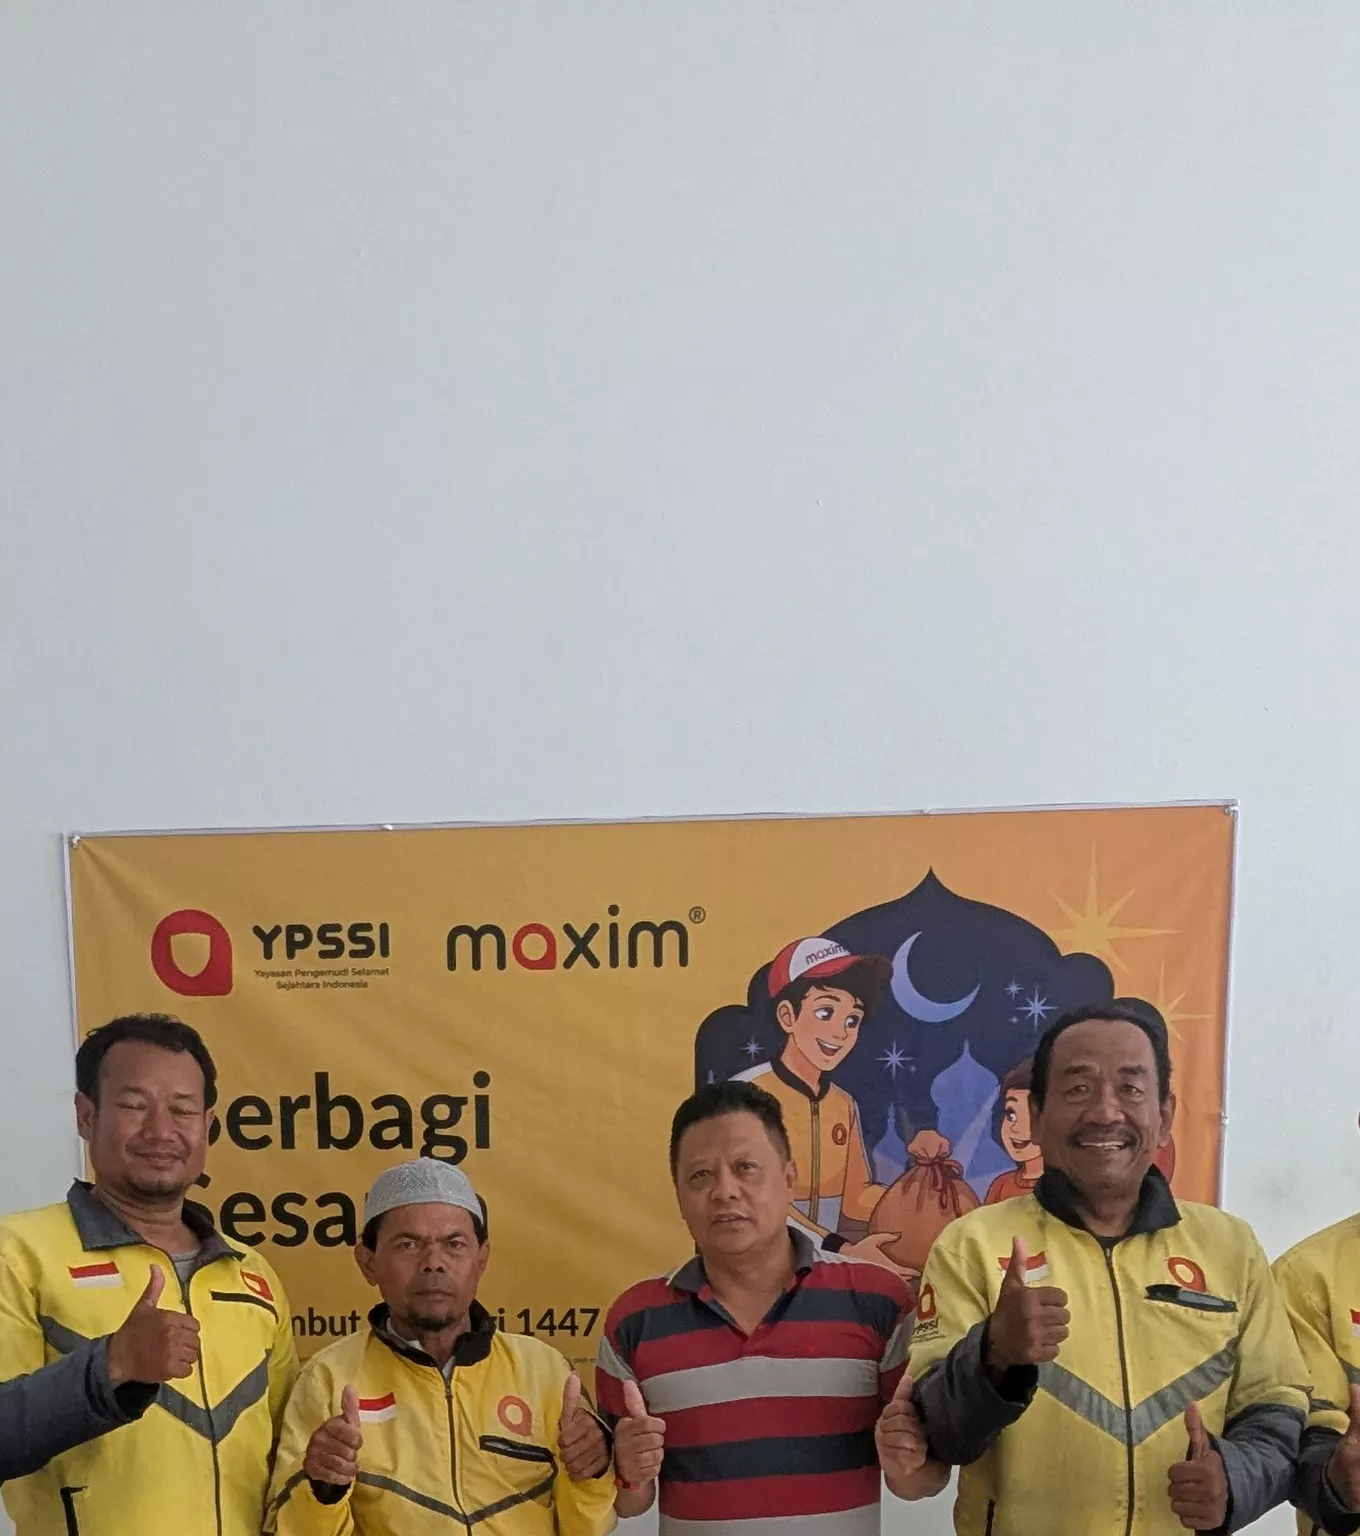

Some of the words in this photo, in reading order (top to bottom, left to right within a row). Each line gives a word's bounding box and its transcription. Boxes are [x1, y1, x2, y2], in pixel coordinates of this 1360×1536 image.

[252, 922, 390, 960] YPSSI
[254, 969, 292, 979] Yayasan
[295, 967, 348, 978] Pengemudi
[352, 967, 389, 976] Selamat
[276, 980, 320, 991] Sejahtera
[323, 980, 368, 989] Indonesia
[517, 1308, 600, 1337] 1447
